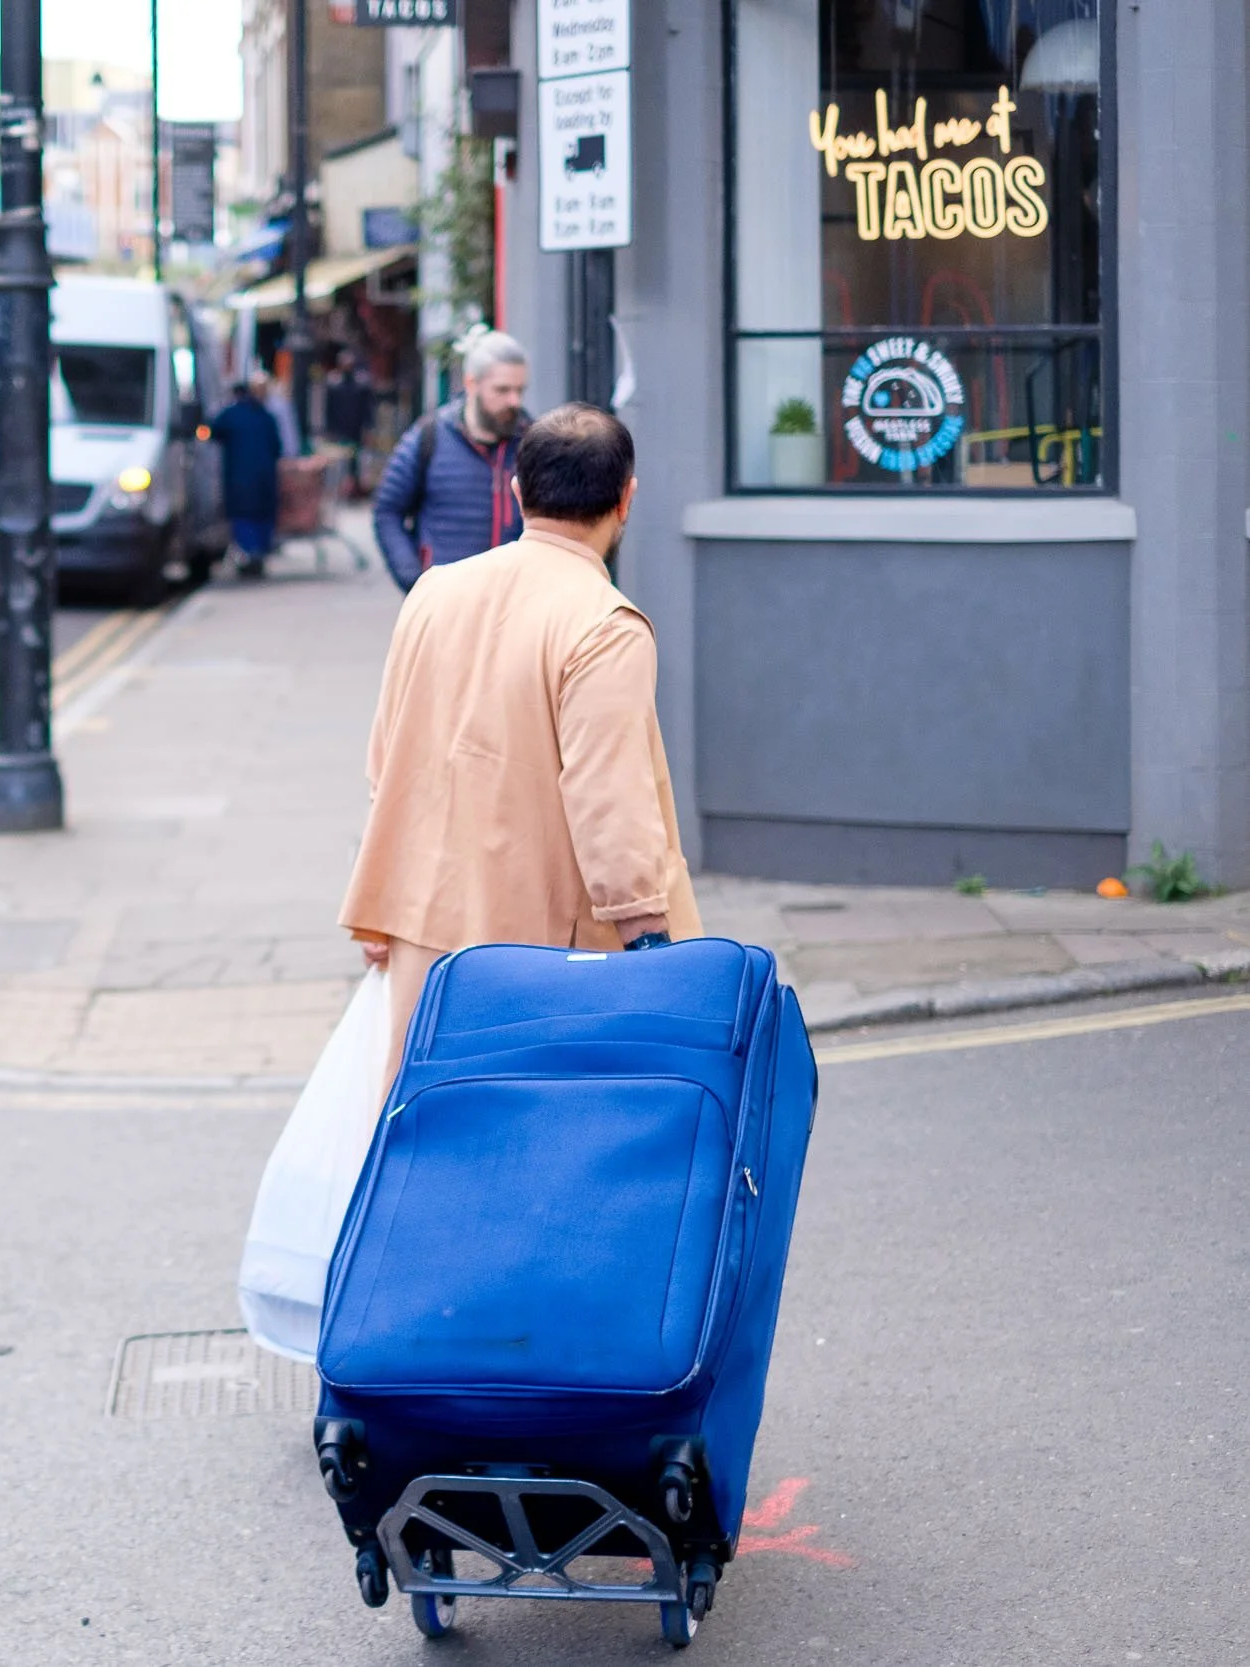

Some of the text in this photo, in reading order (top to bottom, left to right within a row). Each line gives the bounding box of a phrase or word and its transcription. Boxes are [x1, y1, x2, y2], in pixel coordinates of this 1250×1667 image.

[368, 0, 447, 19] TACOS
[552, 17, 614, 37] Wednesday
[809, 84, 1017, 177] You had me at
[845, 156, 1048, 241] TACOS
[866, 337, 914, 366] SWEET
